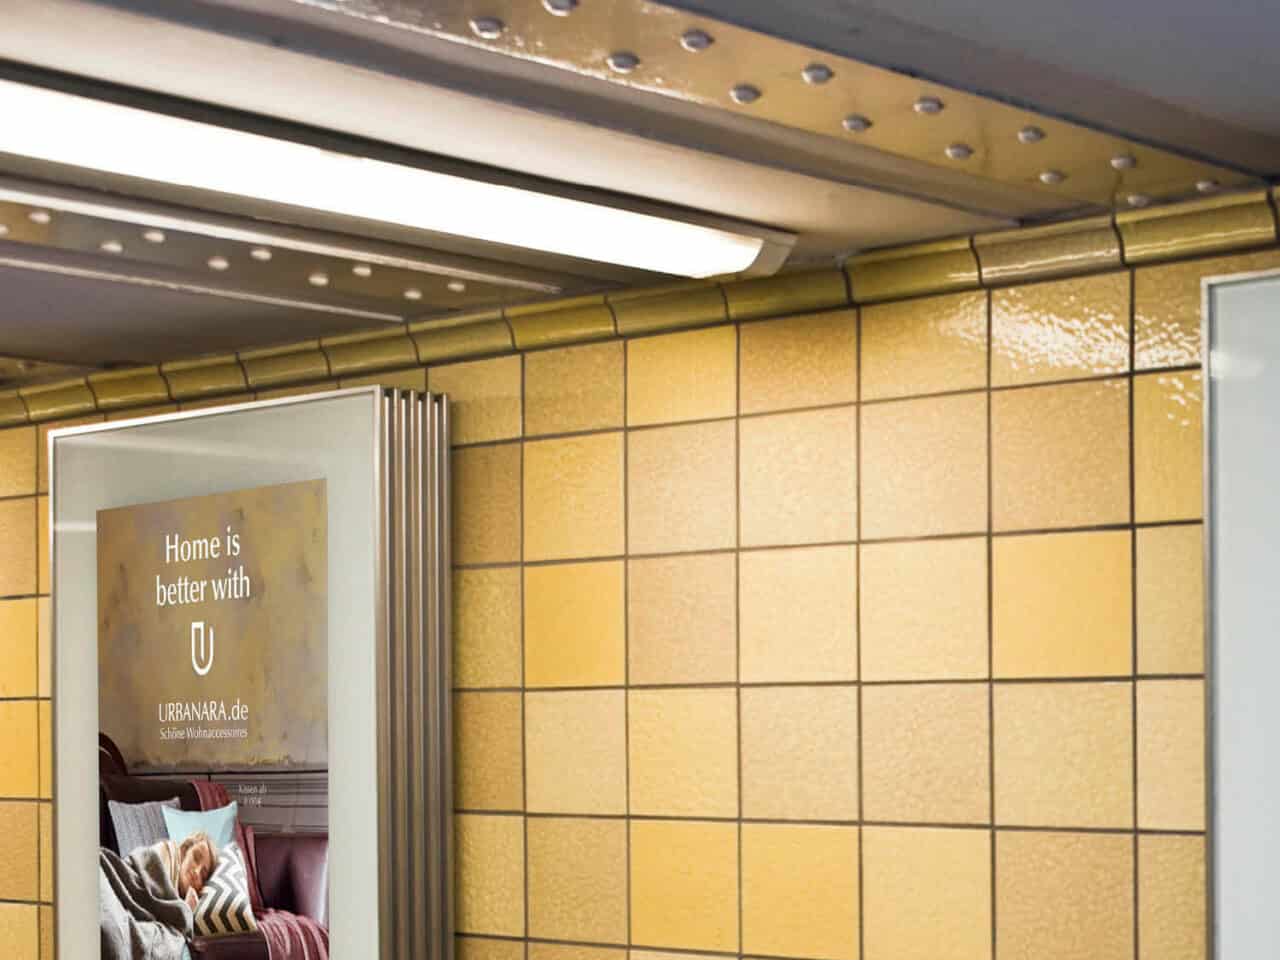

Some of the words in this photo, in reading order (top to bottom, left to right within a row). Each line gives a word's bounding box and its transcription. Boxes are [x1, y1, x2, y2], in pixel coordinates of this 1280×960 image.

[165, 533, 221, 564] Home
[226, 525, 241, 556] is
[156, 574, 208, 606] better
[211, 565, 250, 600] with
[158, 697, 249, 722] URBANARA.de
